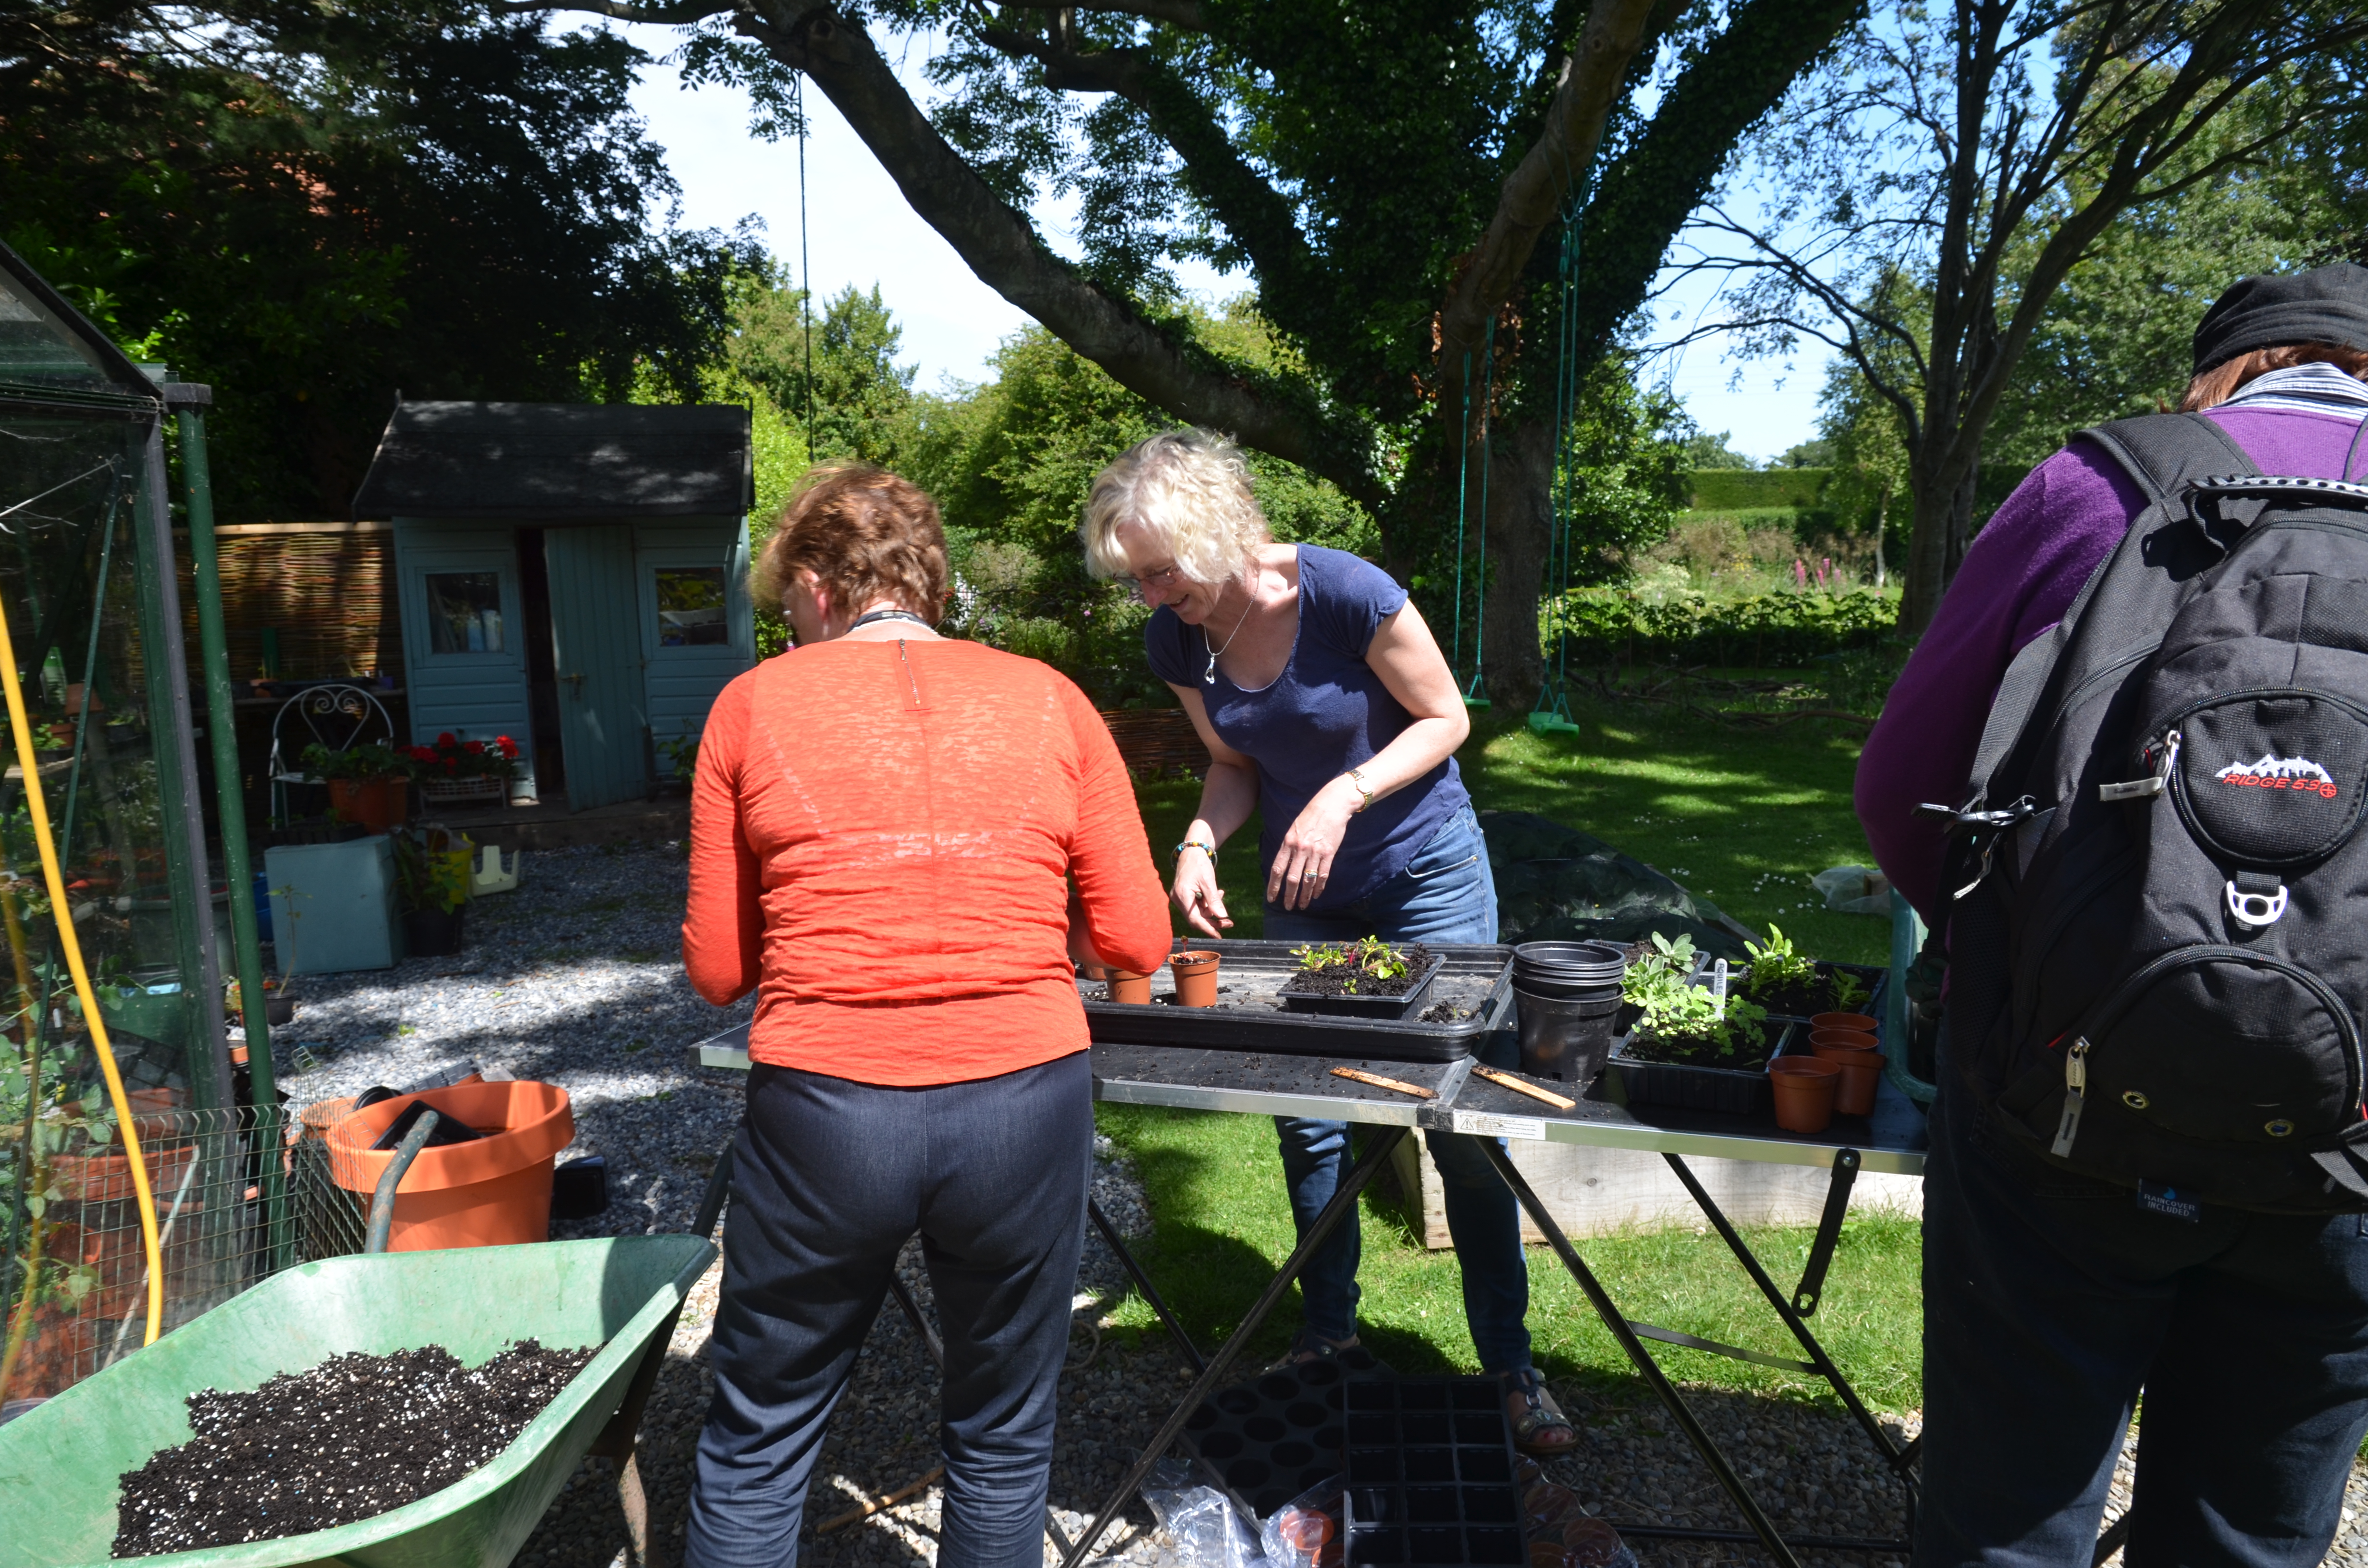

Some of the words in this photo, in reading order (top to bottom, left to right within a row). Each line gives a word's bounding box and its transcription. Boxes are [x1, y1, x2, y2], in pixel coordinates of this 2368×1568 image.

[2223, 774, 2291, 788] RIDGE
[2292, 779, 2321, 791] 53
[2144, 1194, 2195, 1211] RAINCOVER
[2148, 1201, 2189, 1216] INCLUDED
